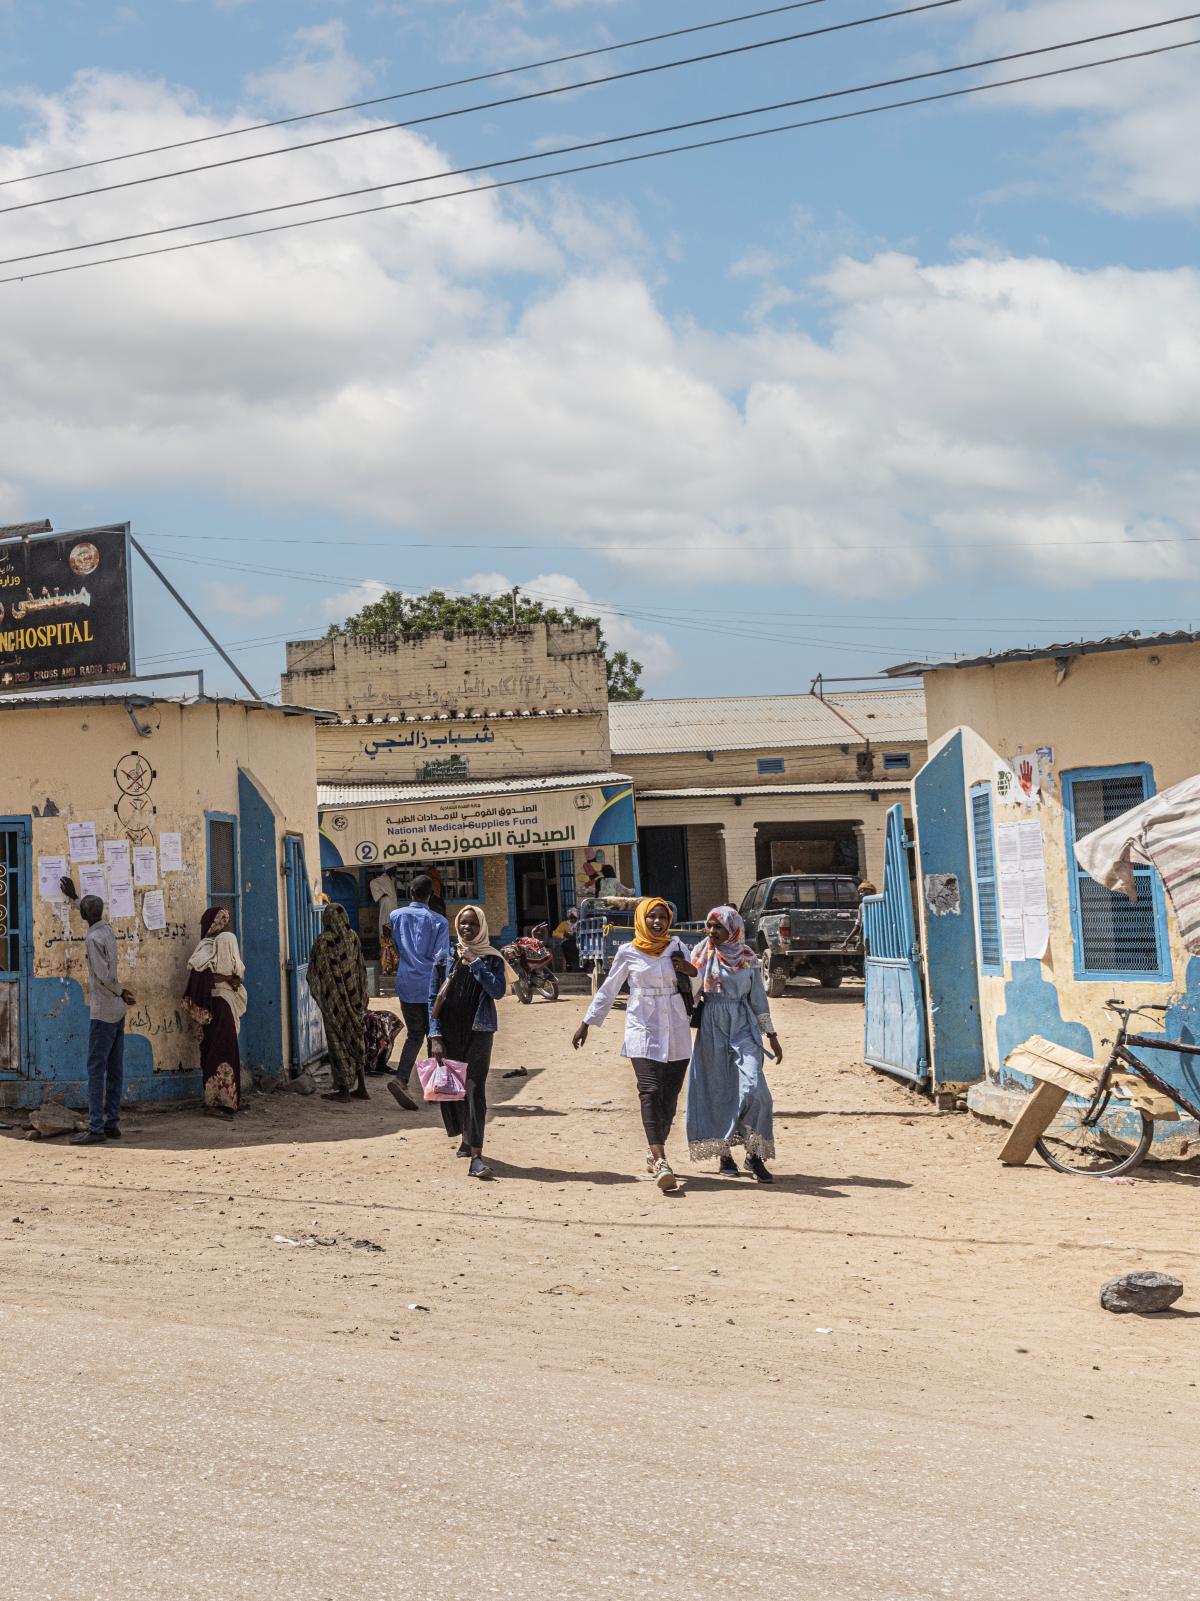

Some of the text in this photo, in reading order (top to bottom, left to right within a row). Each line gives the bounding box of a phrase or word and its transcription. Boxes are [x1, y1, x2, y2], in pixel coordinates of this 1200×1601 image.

[16, 620, 93, 650] HOSPITAL
[33, 668, 58, 680] CROSS
[365, 724, 495, 760] شباب زالنجي
[461, 808, 497, 820] القومي
[498, 804, 538, 816] الصندوق
[386, 814, 415, 825] الطبية
[387, 816, 538, 836] National Medical Supplies Fund
[506, 825, 576, 848] الصيدلية
[361, 845, 373, 860] 2
[383, 839, 417, 859] رقم
